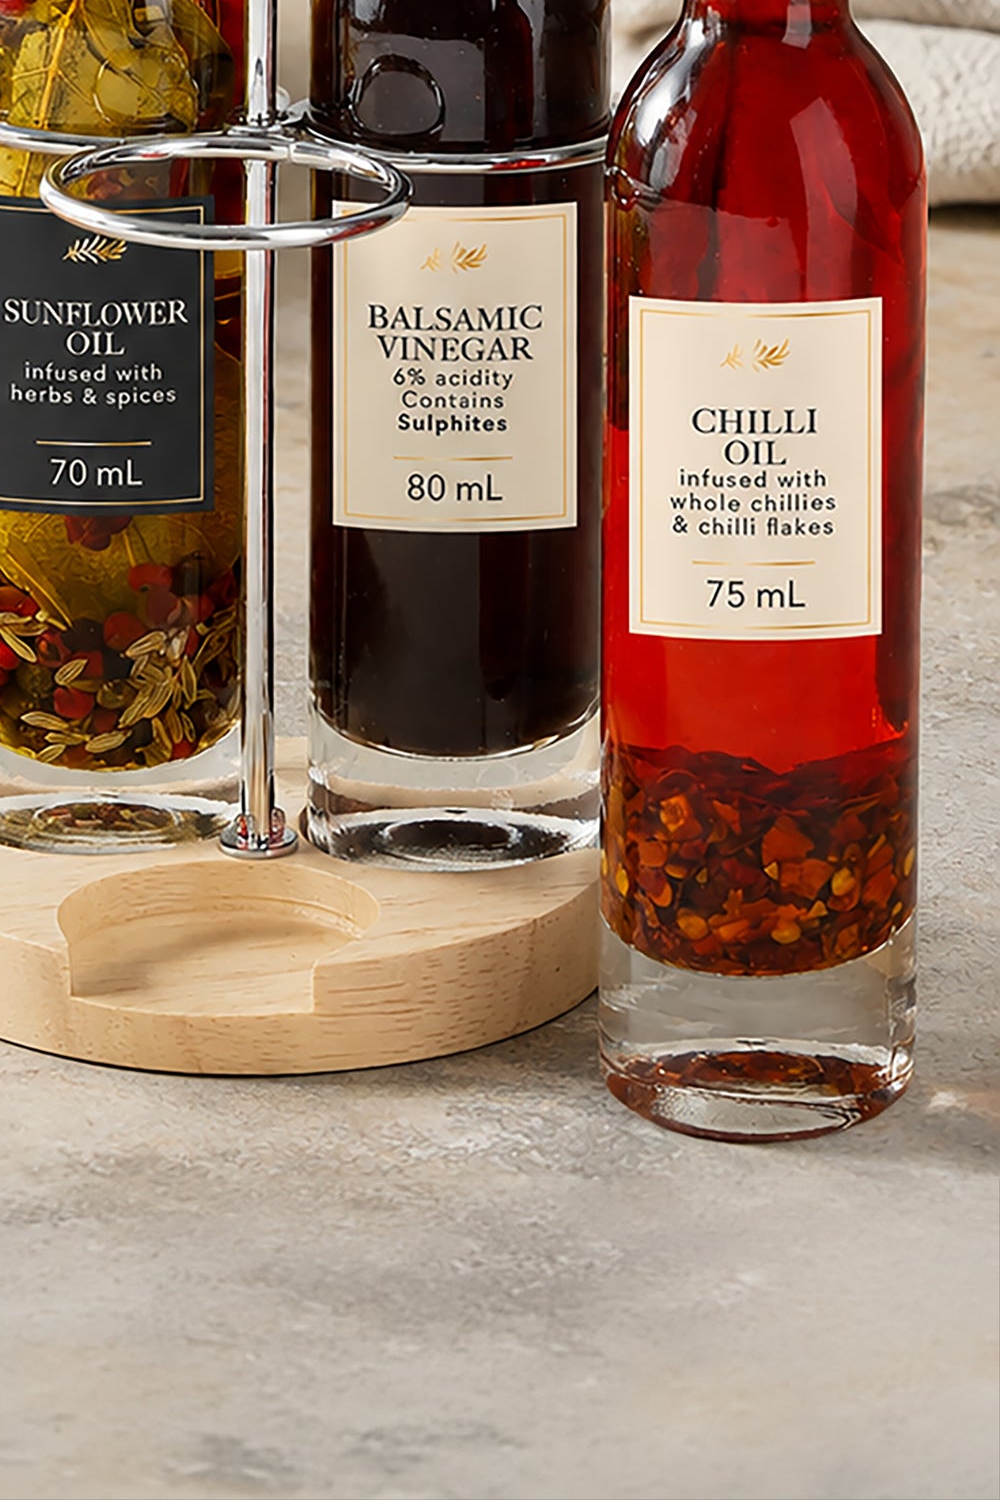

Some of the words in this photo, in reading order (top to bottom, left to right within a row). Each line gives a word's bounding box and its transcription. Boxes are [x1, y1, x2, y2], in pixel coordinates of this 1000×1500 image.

[4, 298, 189, 327] SUNFLOWER
[368, 304, 543, 332] BALSAMIC
[66, 331, 125, 356] OIL
[376, 334, 534, 362] VINEGAR
[25, 361, 106, 383] infused
[115, 363, 162, 382] with
[393, 367, 426, 386] 6%
[435, 368, 513, 391] acidity
[11, 383, 73, 404] herbs
[82, 387, 97, 405] &
[106, 387, 176, 410] spices
[401, 390, 504, 409] Contains
[398, 413, 508, 437] Sulphites
[691, 408, 817, 435] CHILLI
[724, 439, 787, 466] OIL
[50, 458, 87, 486] 70
[97, 459, 143, 486] mL
[680, 468, 767, 489] infused
[777, 469, 826, 488] with
[407, 473, 446, 502] 80
[456, 473, 503, 502] mL
[670, 492, 741, 513] whole
[750, 493, 836, 513] chillies
[672, 515, 688, 534] &
[698, 516, 756, 536] chilli
[766, 516, 834, 537] flakes
[706, 579, 745, 609] 75
[757, 579, 806, 608] mL
